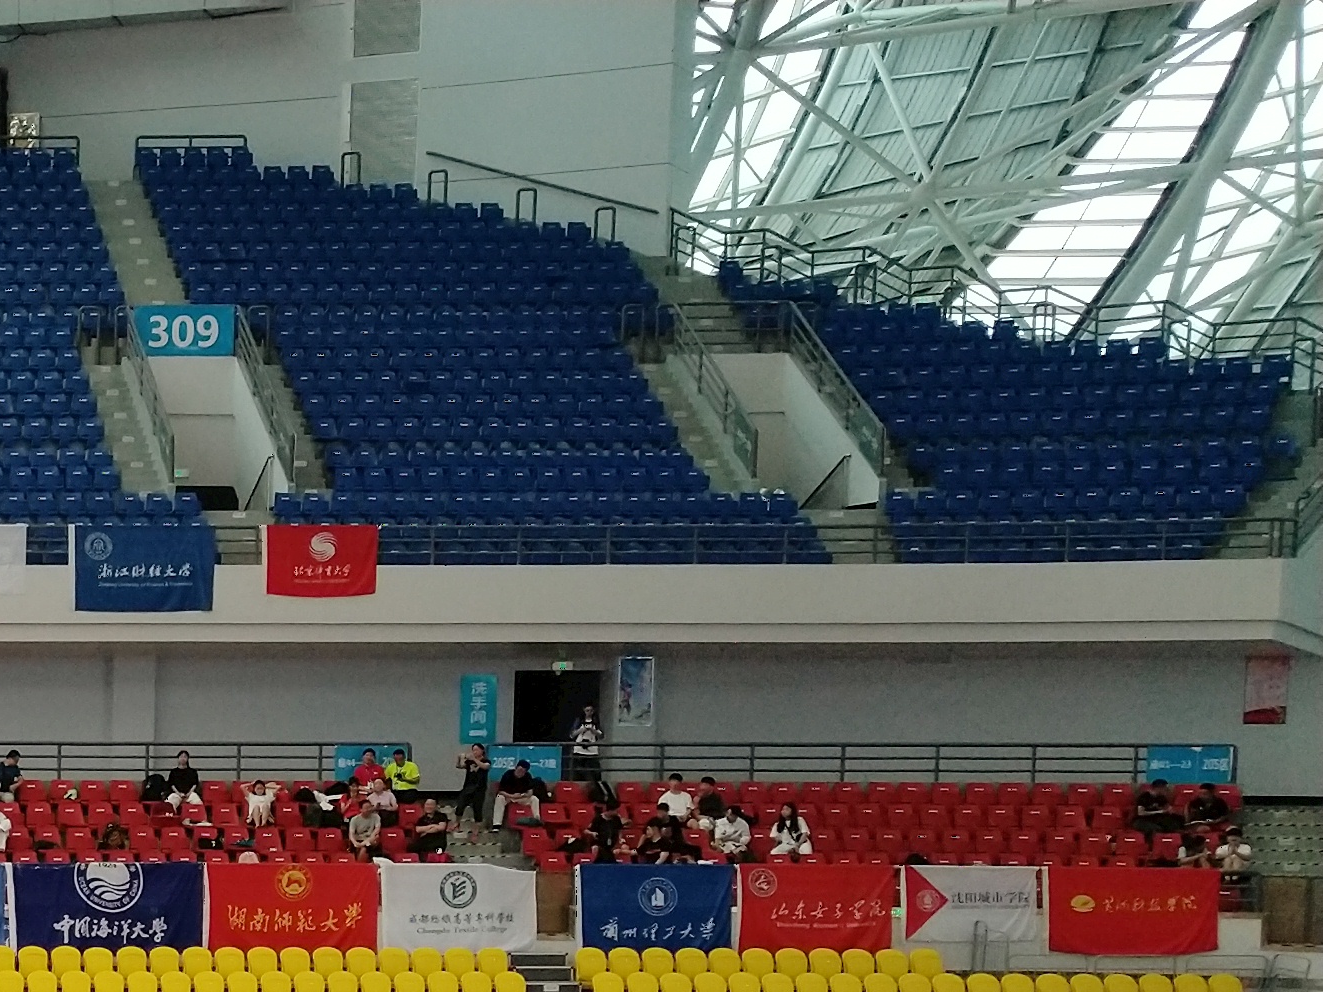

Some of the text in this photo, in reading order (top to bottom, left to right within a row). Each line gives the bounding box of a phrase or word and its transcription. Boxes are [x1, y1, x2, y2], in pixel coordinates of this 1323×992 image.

[148, 315, 219, 347] 309
[470, 681, 487, 722] 洗手间
